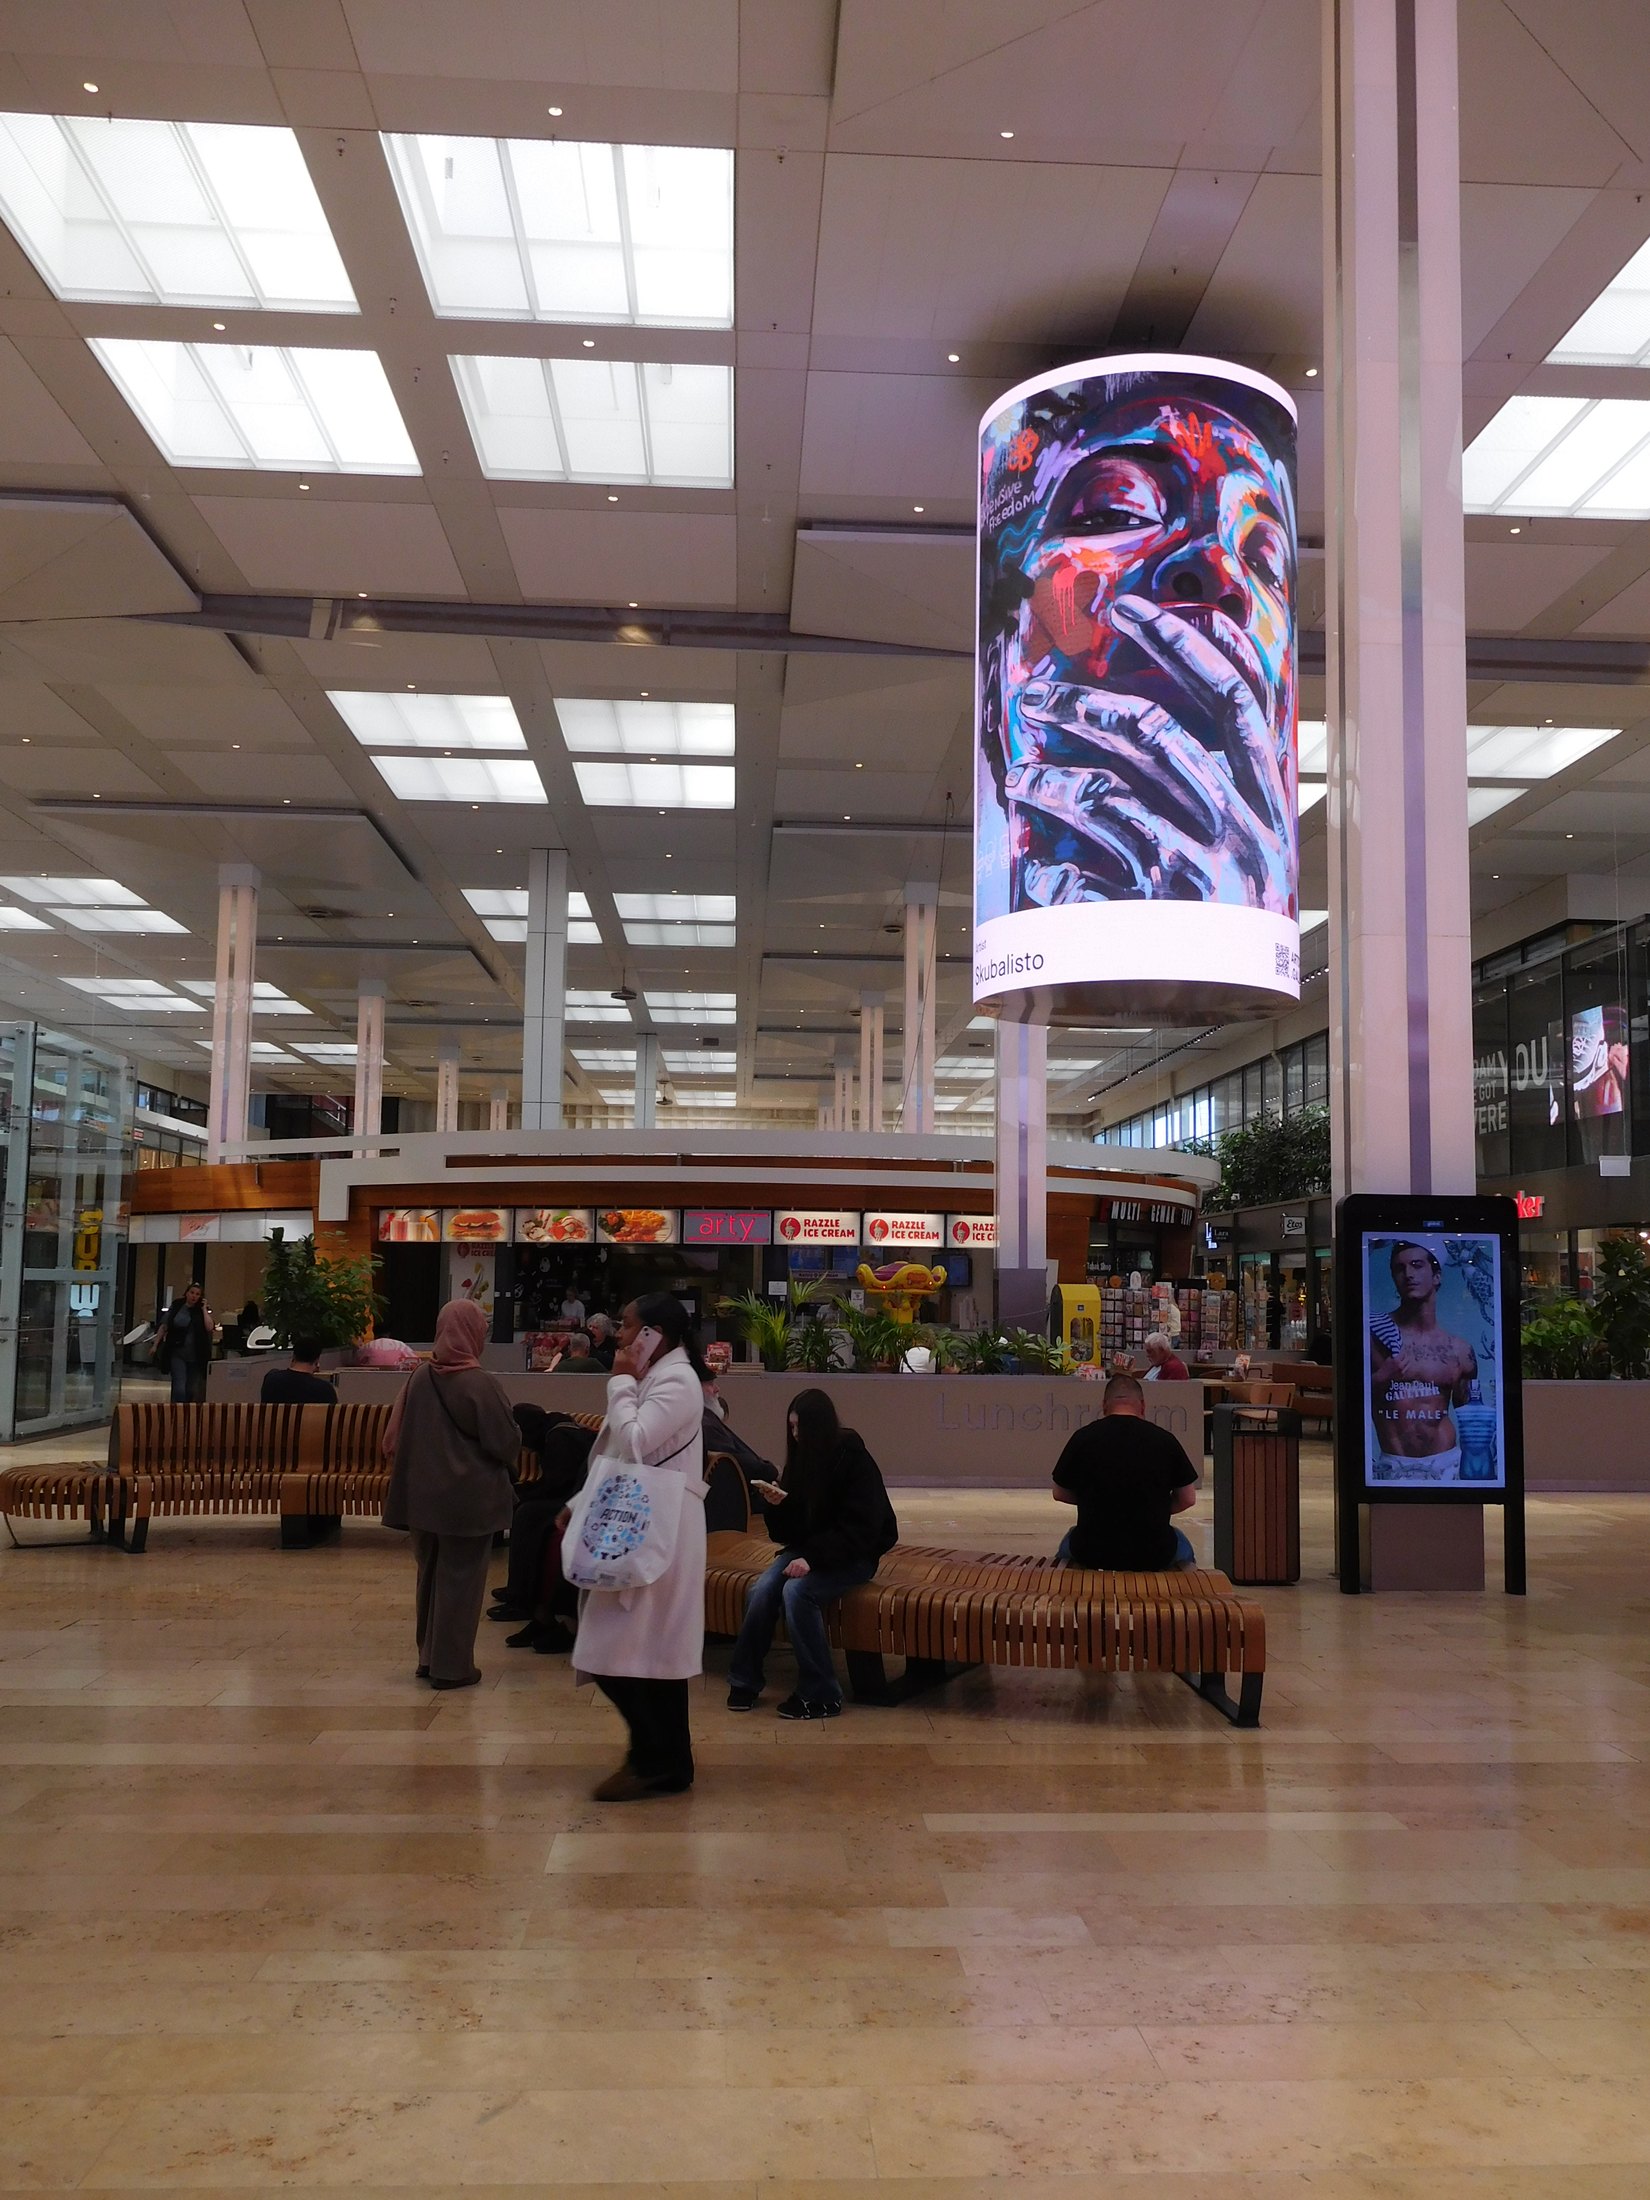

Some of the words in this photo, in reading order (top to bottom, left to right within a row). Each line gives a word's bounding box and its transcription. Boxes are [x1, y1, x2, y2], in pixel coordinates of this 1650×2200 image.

[974, 952, 1044, 986] Skubalisto
[1497, 1035, 1548, 1095] YOU
[1479, 1079, 1497, 1101] GOT
[1111, 1200, 1141, 1221] MULTI
[1513, 1189, 1545, 1219] ker
[803, 1218, 840, 1228] RAZZLE
[891, 1220, 926, 1230] RAZZLE
[803, 1228, 820, 1238] ICE
[820, 1228, 855, 1238] CREAM
[891, 1230, 906, 1239] ICE
[907, 1230, 940, 1240] CREAM
[972, 1232, 986, 1241] ICE
[1389, 1380, 1411, 1391] Jean
[1412, 1379, 1434, 1391] Paul
[936, 1392, 1188, 1431] Lunchrm
[600, 1508, 639, 1524] ACTION
